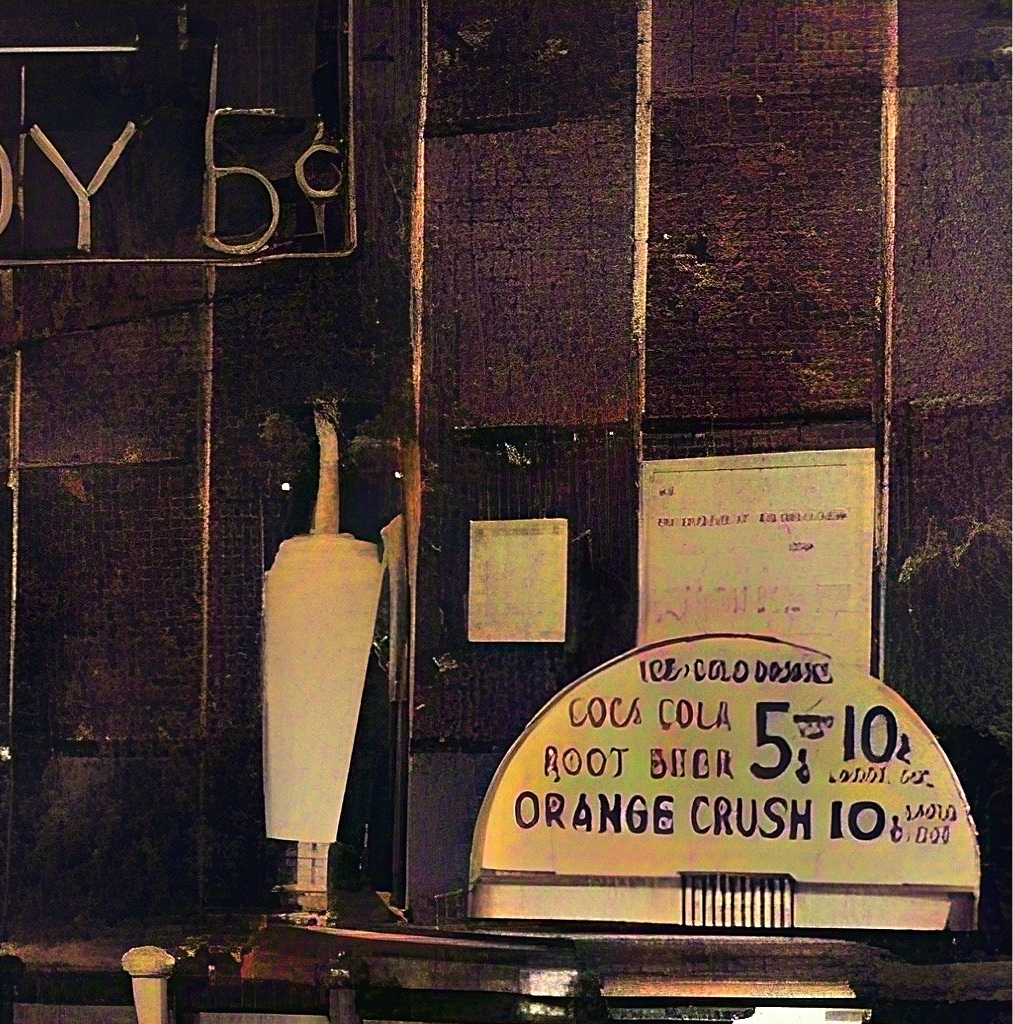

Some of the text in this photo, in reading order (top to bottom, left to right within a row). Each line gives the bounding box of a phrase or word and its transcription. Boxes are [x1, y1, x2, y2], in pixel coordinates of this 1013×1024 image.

[568, 696, 732, 732] COCA COLA
[544, 744, 629, 783] ROOT
[513, 790, 675, 835] ORANGE
[690, 794, 813, 841] CRUSH
